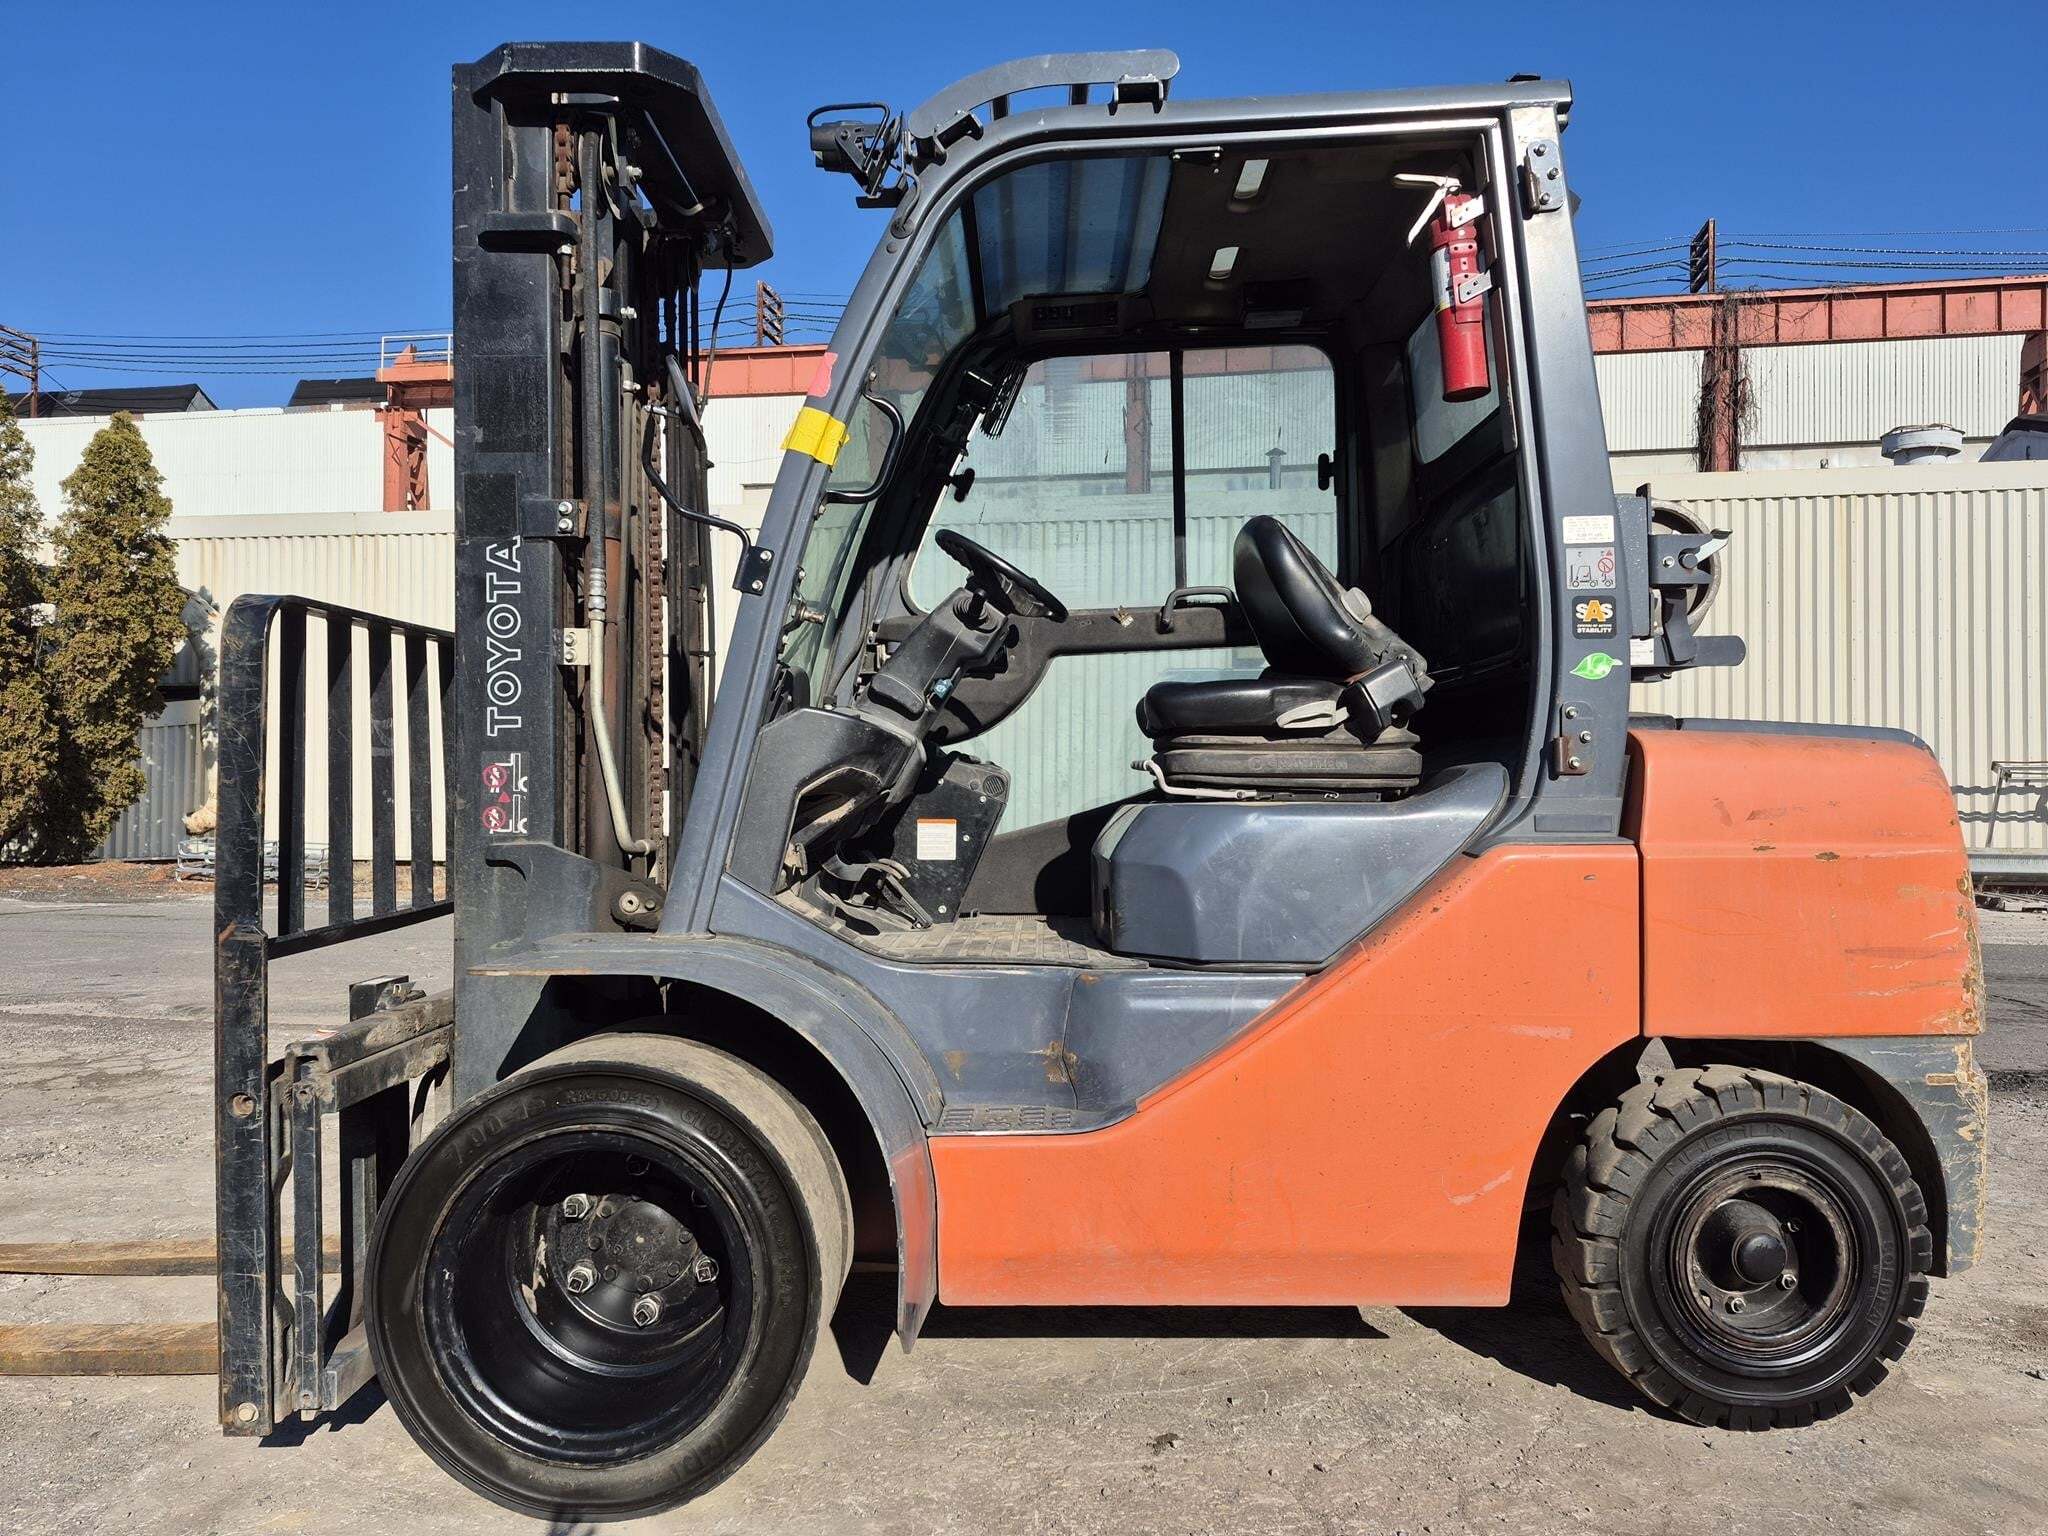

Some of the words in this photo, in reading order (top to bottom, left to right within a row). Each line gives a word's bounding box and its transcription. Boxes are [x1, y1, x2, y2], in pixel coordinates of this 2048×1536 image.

[486, 536, 522, 737] TOYOTA
[1575, 599, 1613, 622] SAS
[678, 1102, 777, 1212] GLOBESTAR
